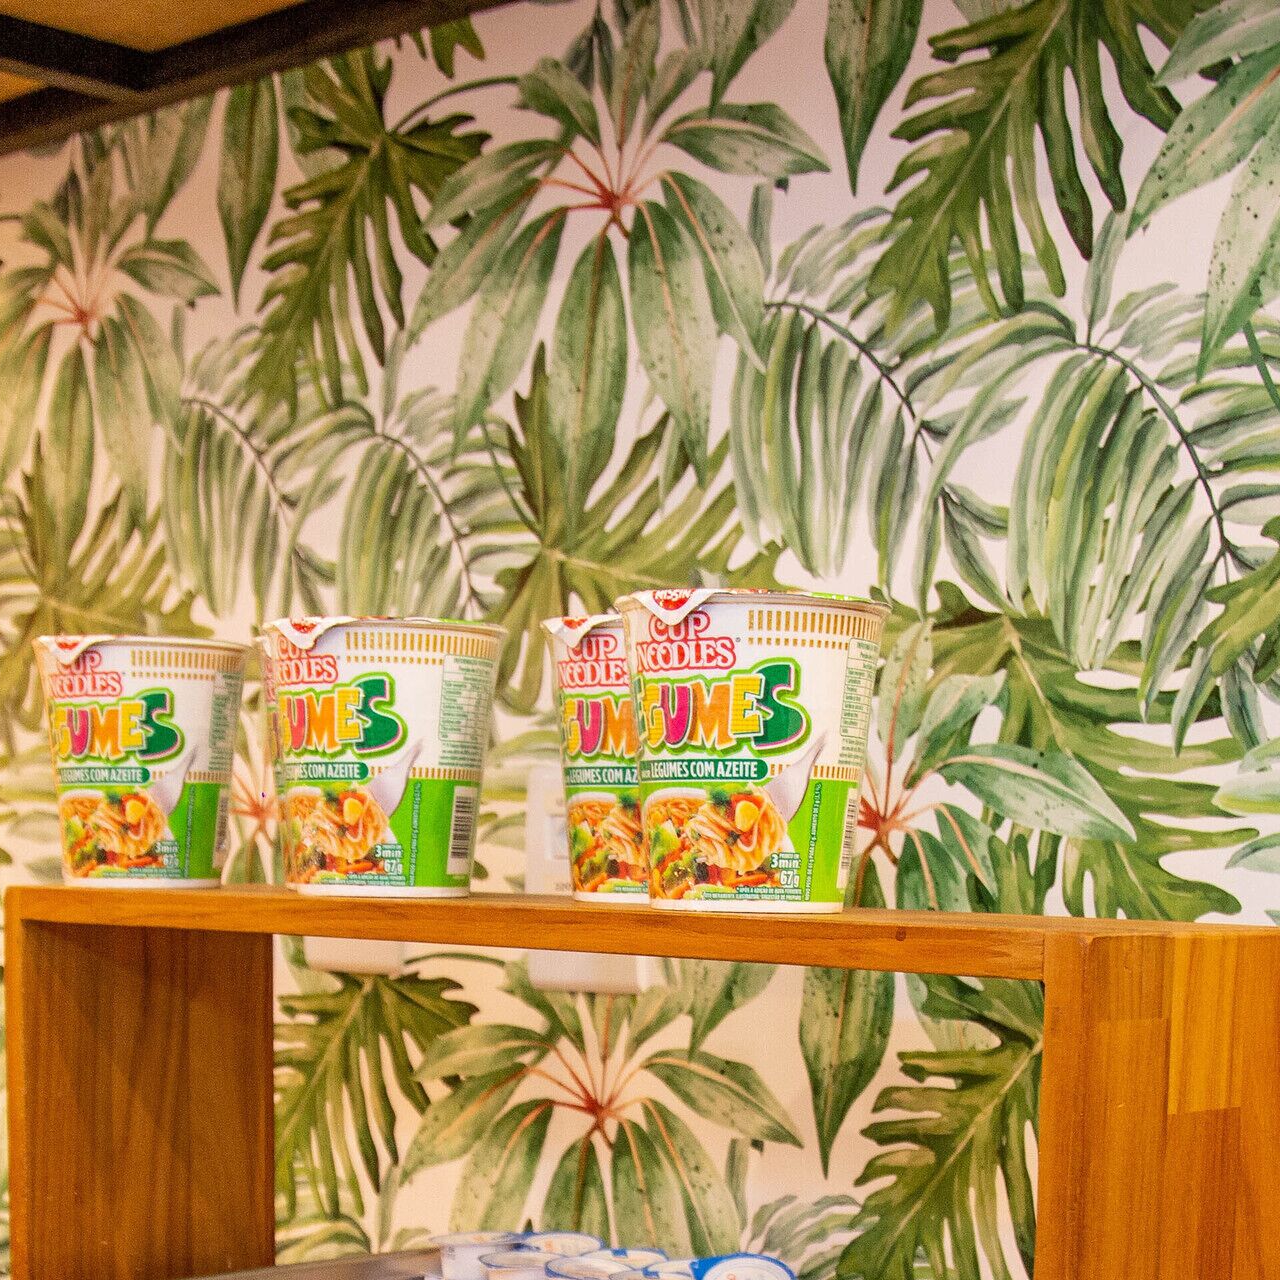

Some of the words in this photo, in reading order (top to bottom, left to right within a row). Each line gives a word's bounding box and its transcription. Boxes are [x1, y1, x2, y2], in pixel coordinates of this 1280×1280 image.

[650, 610, 710, 641] CUP
[636, 637, 736, 672] NOODLES
[308, 763, 327, 779] COM
[327, 763, 360, 779] AZEITE
[602, 768, 623, 783] COM
[651, 761, 689, 778] LEGUMES
[690, 761, 715, 778] COM
[717, 761, 758, 778] AZEITE
